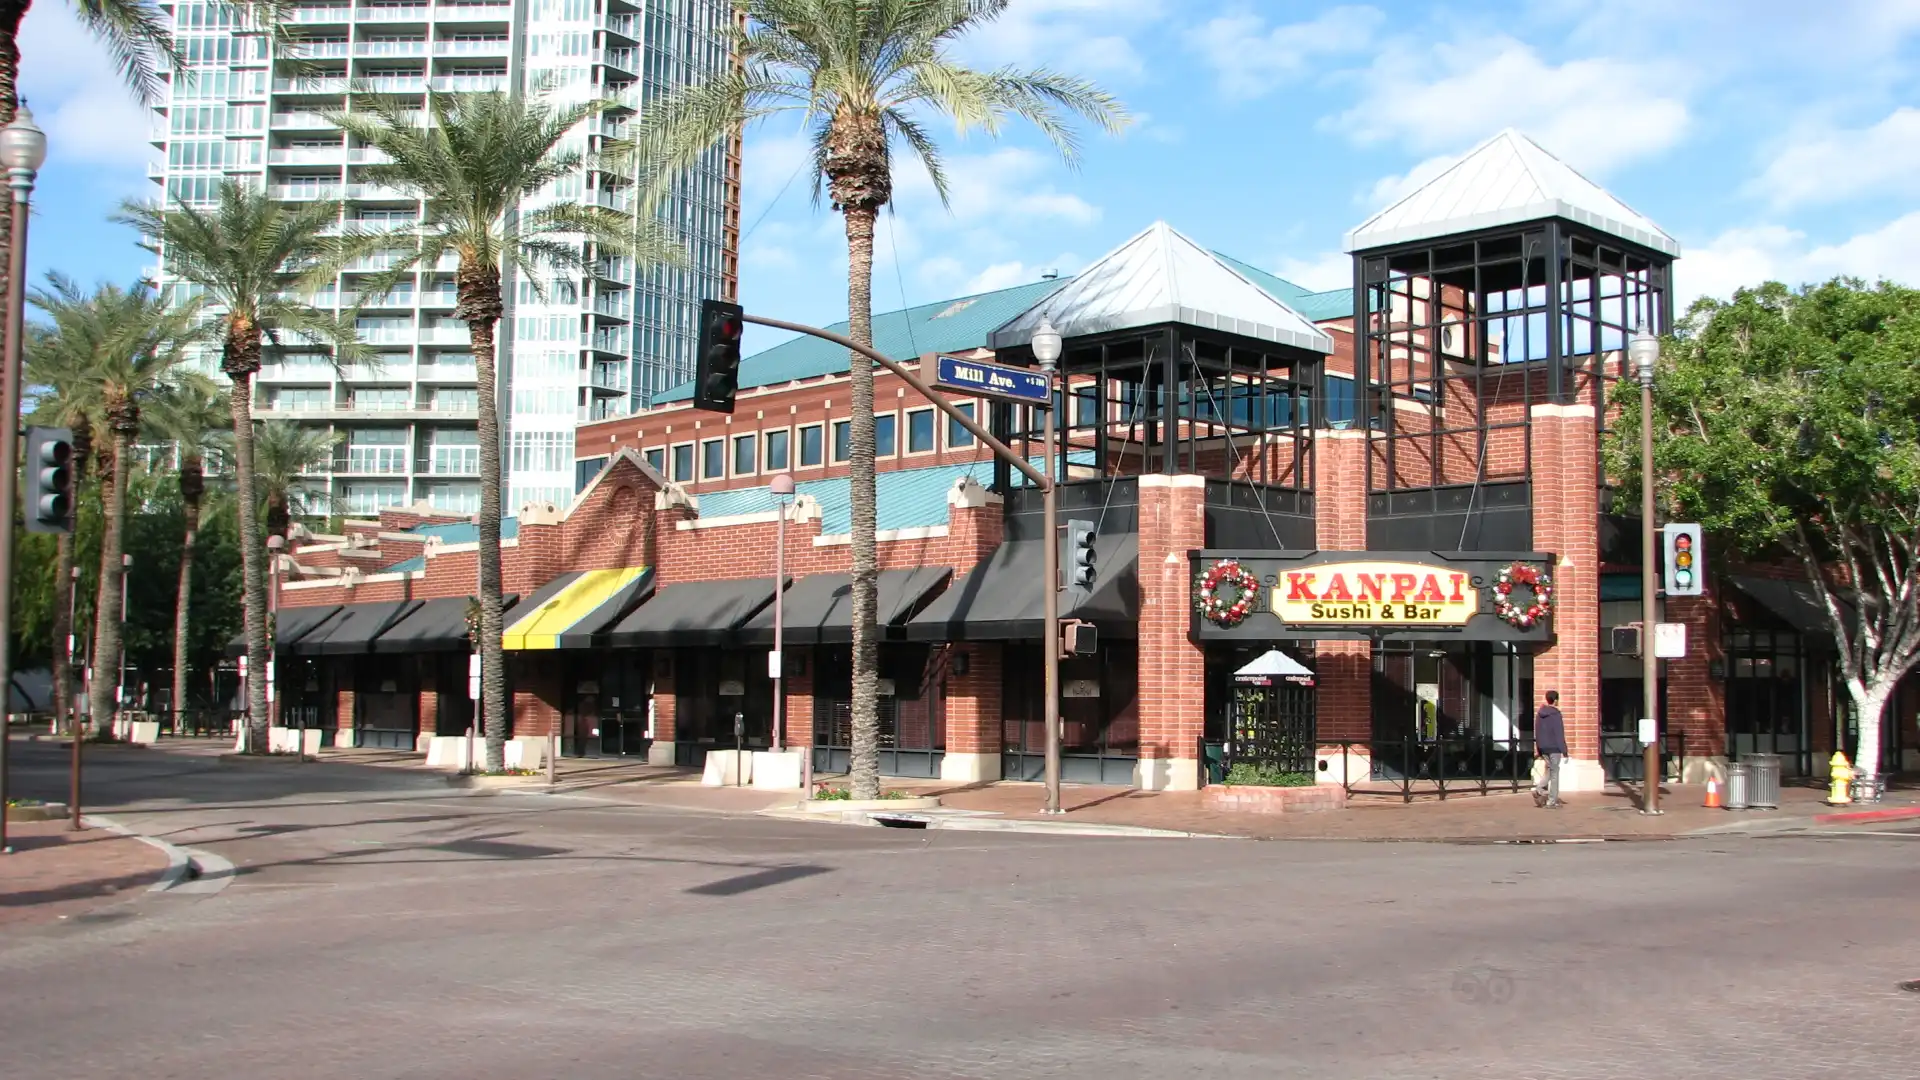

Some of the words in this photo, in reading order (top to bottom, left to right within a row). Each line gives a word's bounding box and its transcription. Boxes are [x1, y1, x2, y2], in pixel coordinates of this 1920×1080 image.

[954, 366, 984, 383] Mill
[988, 372, 1016, 388] Ave.
[1286, 573, 1464, 602] KANPAI
[1311, 603, 1371, 619] Sushi
[1380, 603, 1394, 619] &
[1404, 604, 1441, 619] Bar
